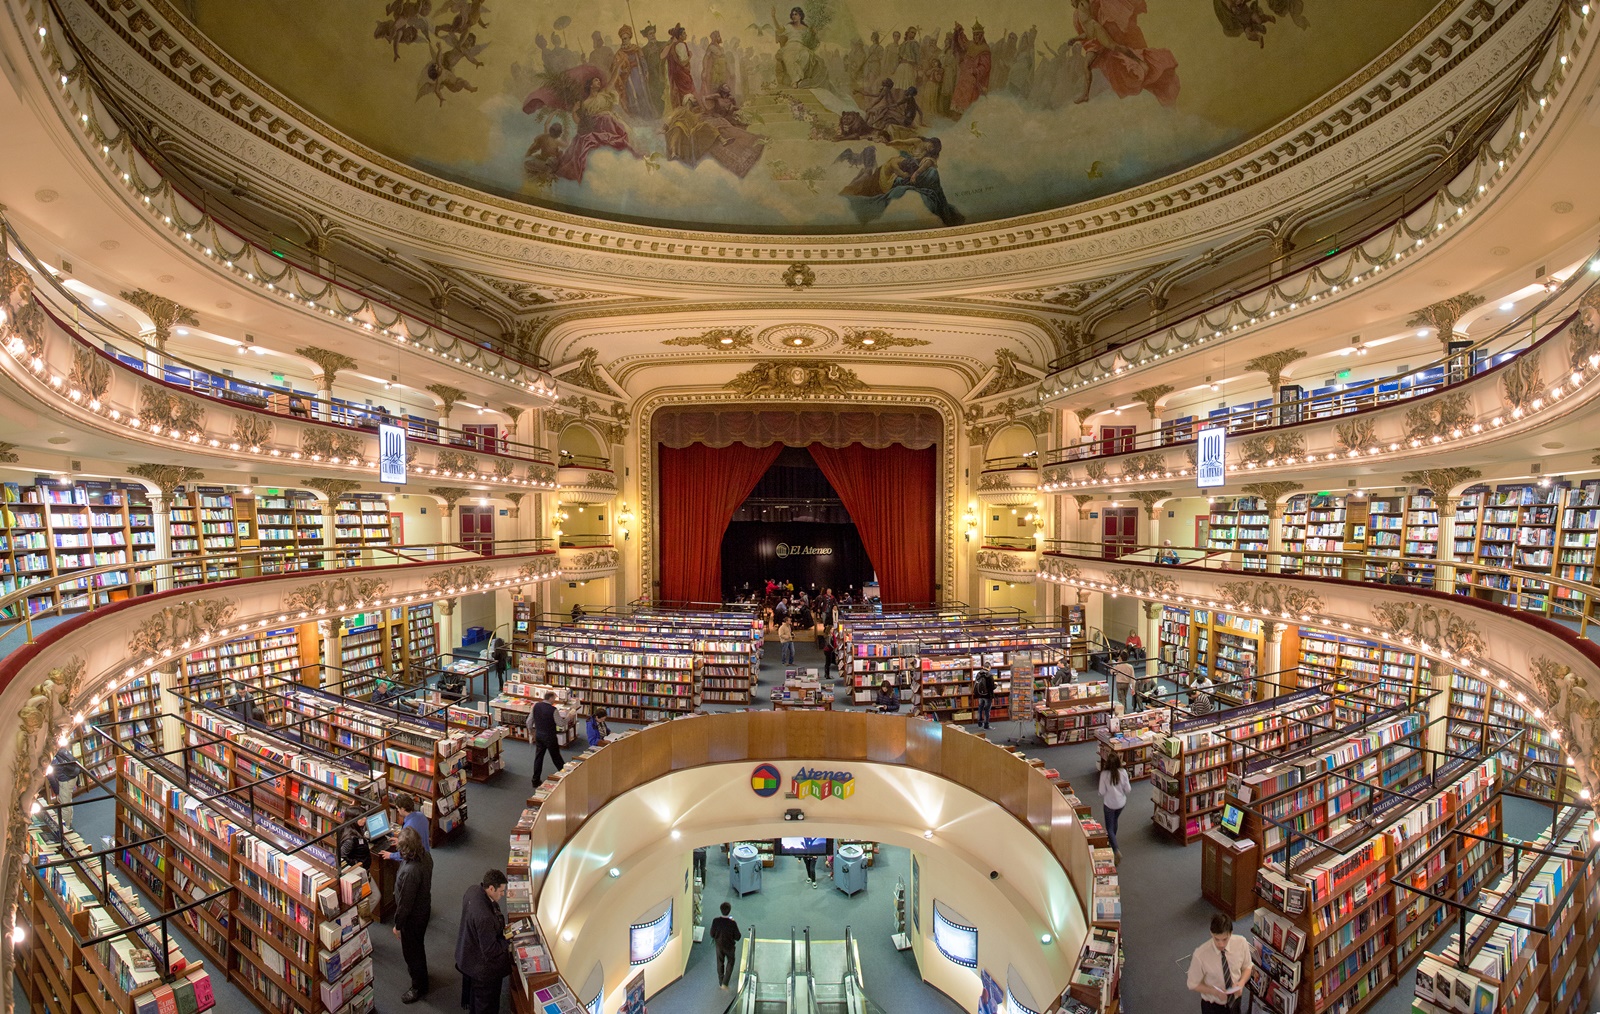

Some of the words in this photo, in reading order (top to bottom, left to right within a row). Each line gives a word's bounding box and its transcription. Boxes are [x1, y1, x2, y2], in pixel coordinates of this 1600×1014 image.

[385, 431, 402, 459] 100
[1203, 434, 1221, 462] 100
[389, 464, 404, 475] ATENEO
[1206, 467, 1223, 478] ATENEO
[789, 545, 801, 556] El
[801, 545, 833, 556] Ateneo
[793, 766, 853, 781] Ateneo
[792, 781, 854, 798] Junior
[260, 818, 292, 841] LITERATURA
[291, 836, 327, 860] ARGNTINA
